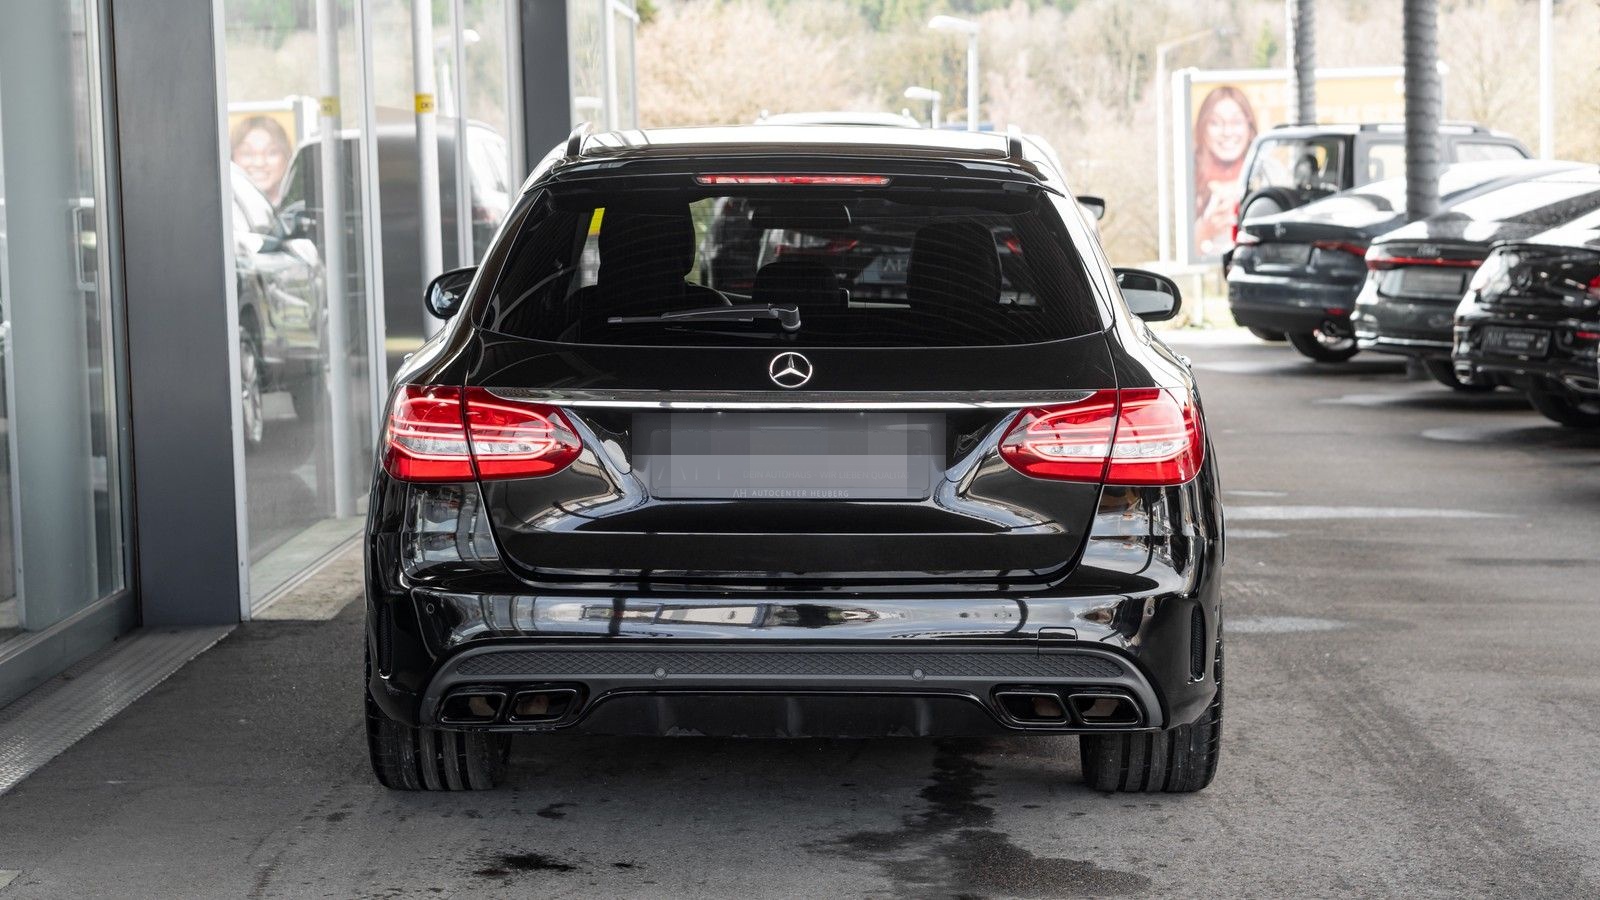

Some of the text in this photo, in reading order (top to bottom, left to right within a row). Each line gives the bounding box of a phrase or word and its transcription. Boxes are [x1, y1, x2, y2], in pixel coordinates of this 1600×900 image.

[743, 470, 763, 479] DEIN
[766, 470, 811, 479] AUTOHAUS
[819, 470, 837, 479] WIR
[839, 470, 869, 479] LIEBEN
[751, 489, 807, 497] AUTOCENTER
[810, 489, 849, 498] HEUBERG
